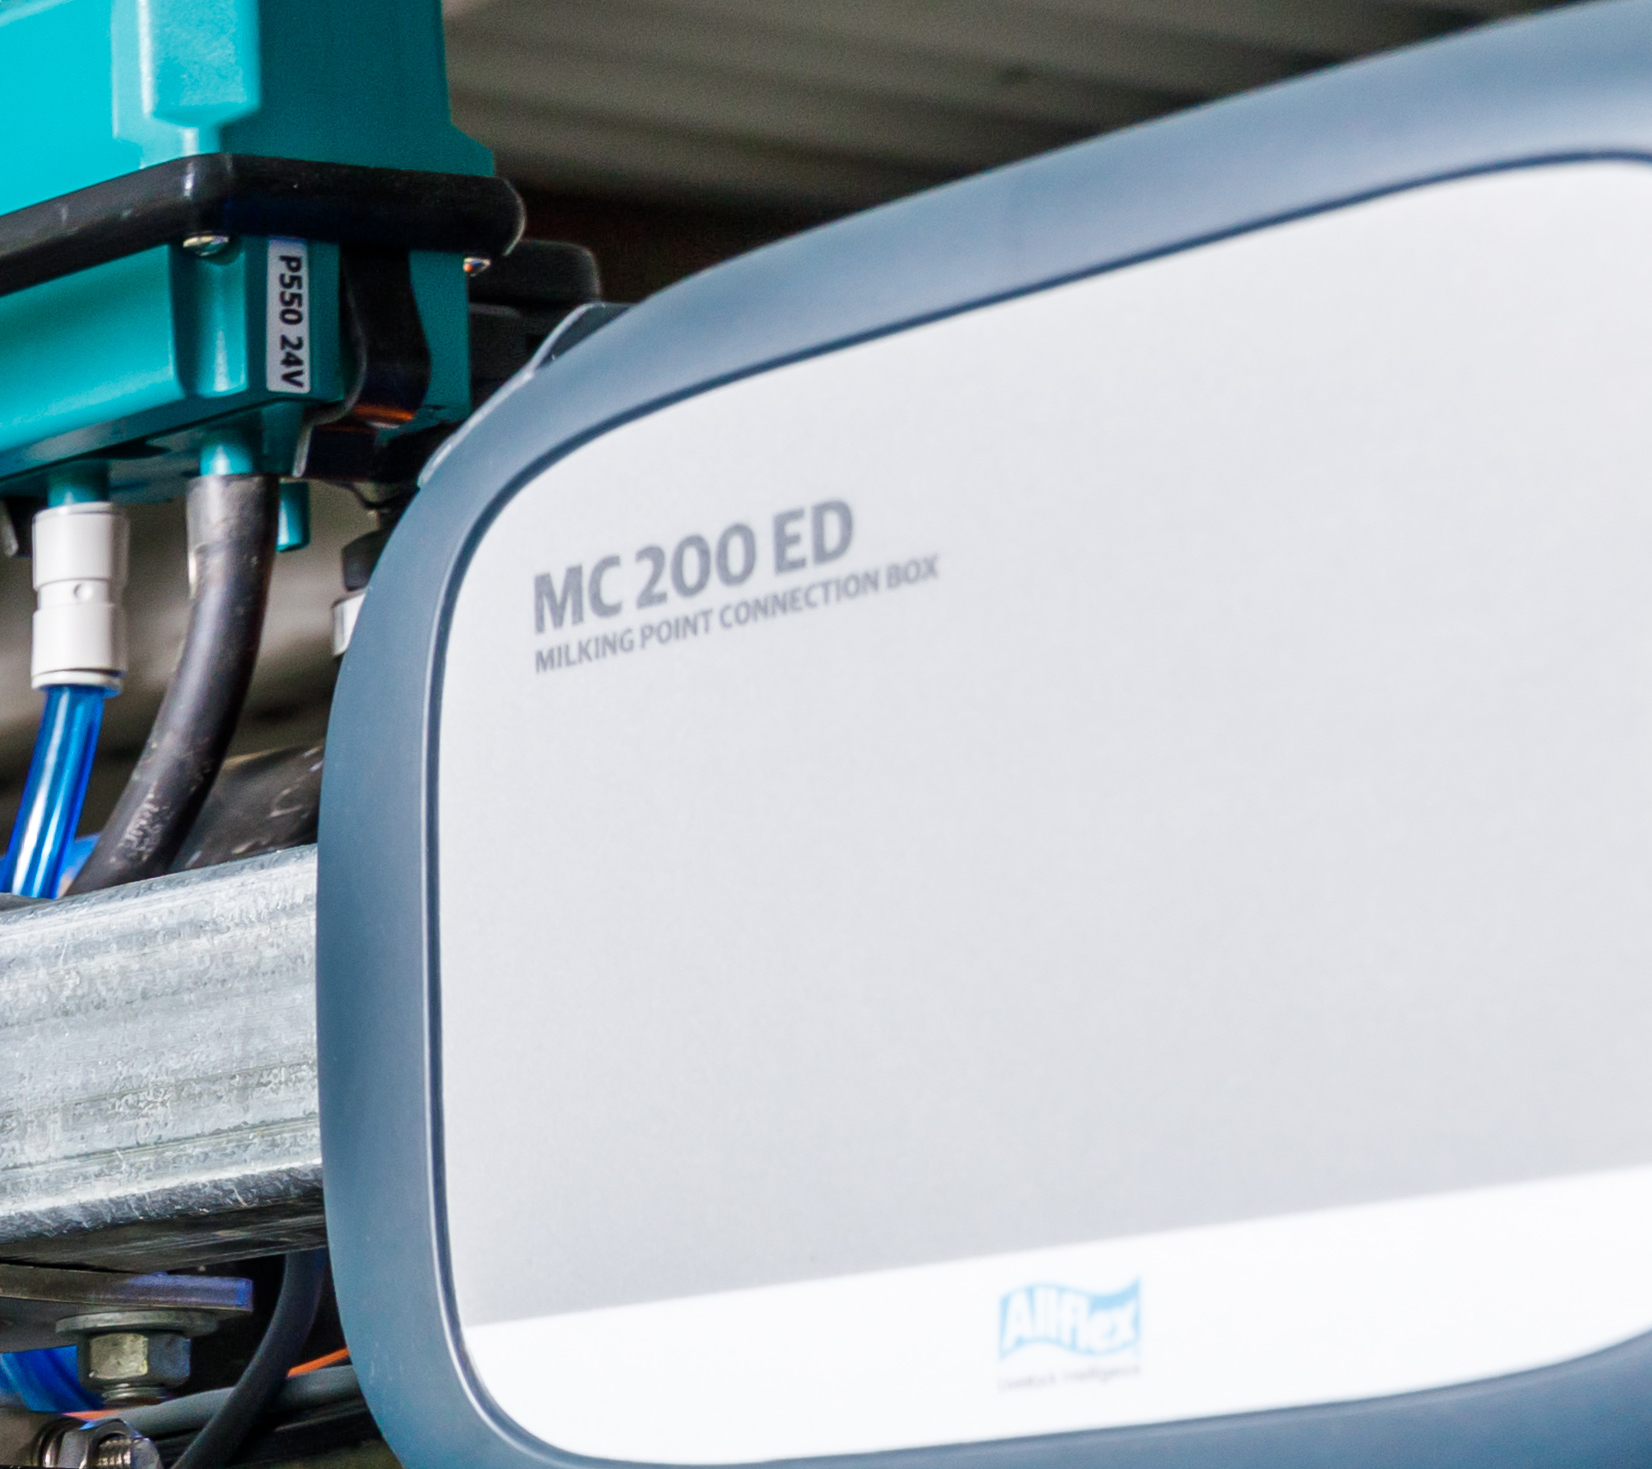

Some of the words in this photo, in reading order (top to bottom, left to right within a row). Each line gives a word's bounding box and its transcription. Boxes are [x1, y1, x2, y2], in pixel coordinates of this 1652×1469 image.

[279, 255, 304, 325] P550
[280, 334, 304, 388] 24V
[534, 555, 622, 634] MC
[635, 522, 757, 609] 200
[773, 499, 854, 575] ED
[535, 628, 634, 674] MILKING
[641, 608, 713, 650] POINT
[719, 569, 880, 630] CONNECTION
[884, 553, 940, 589] BOX
